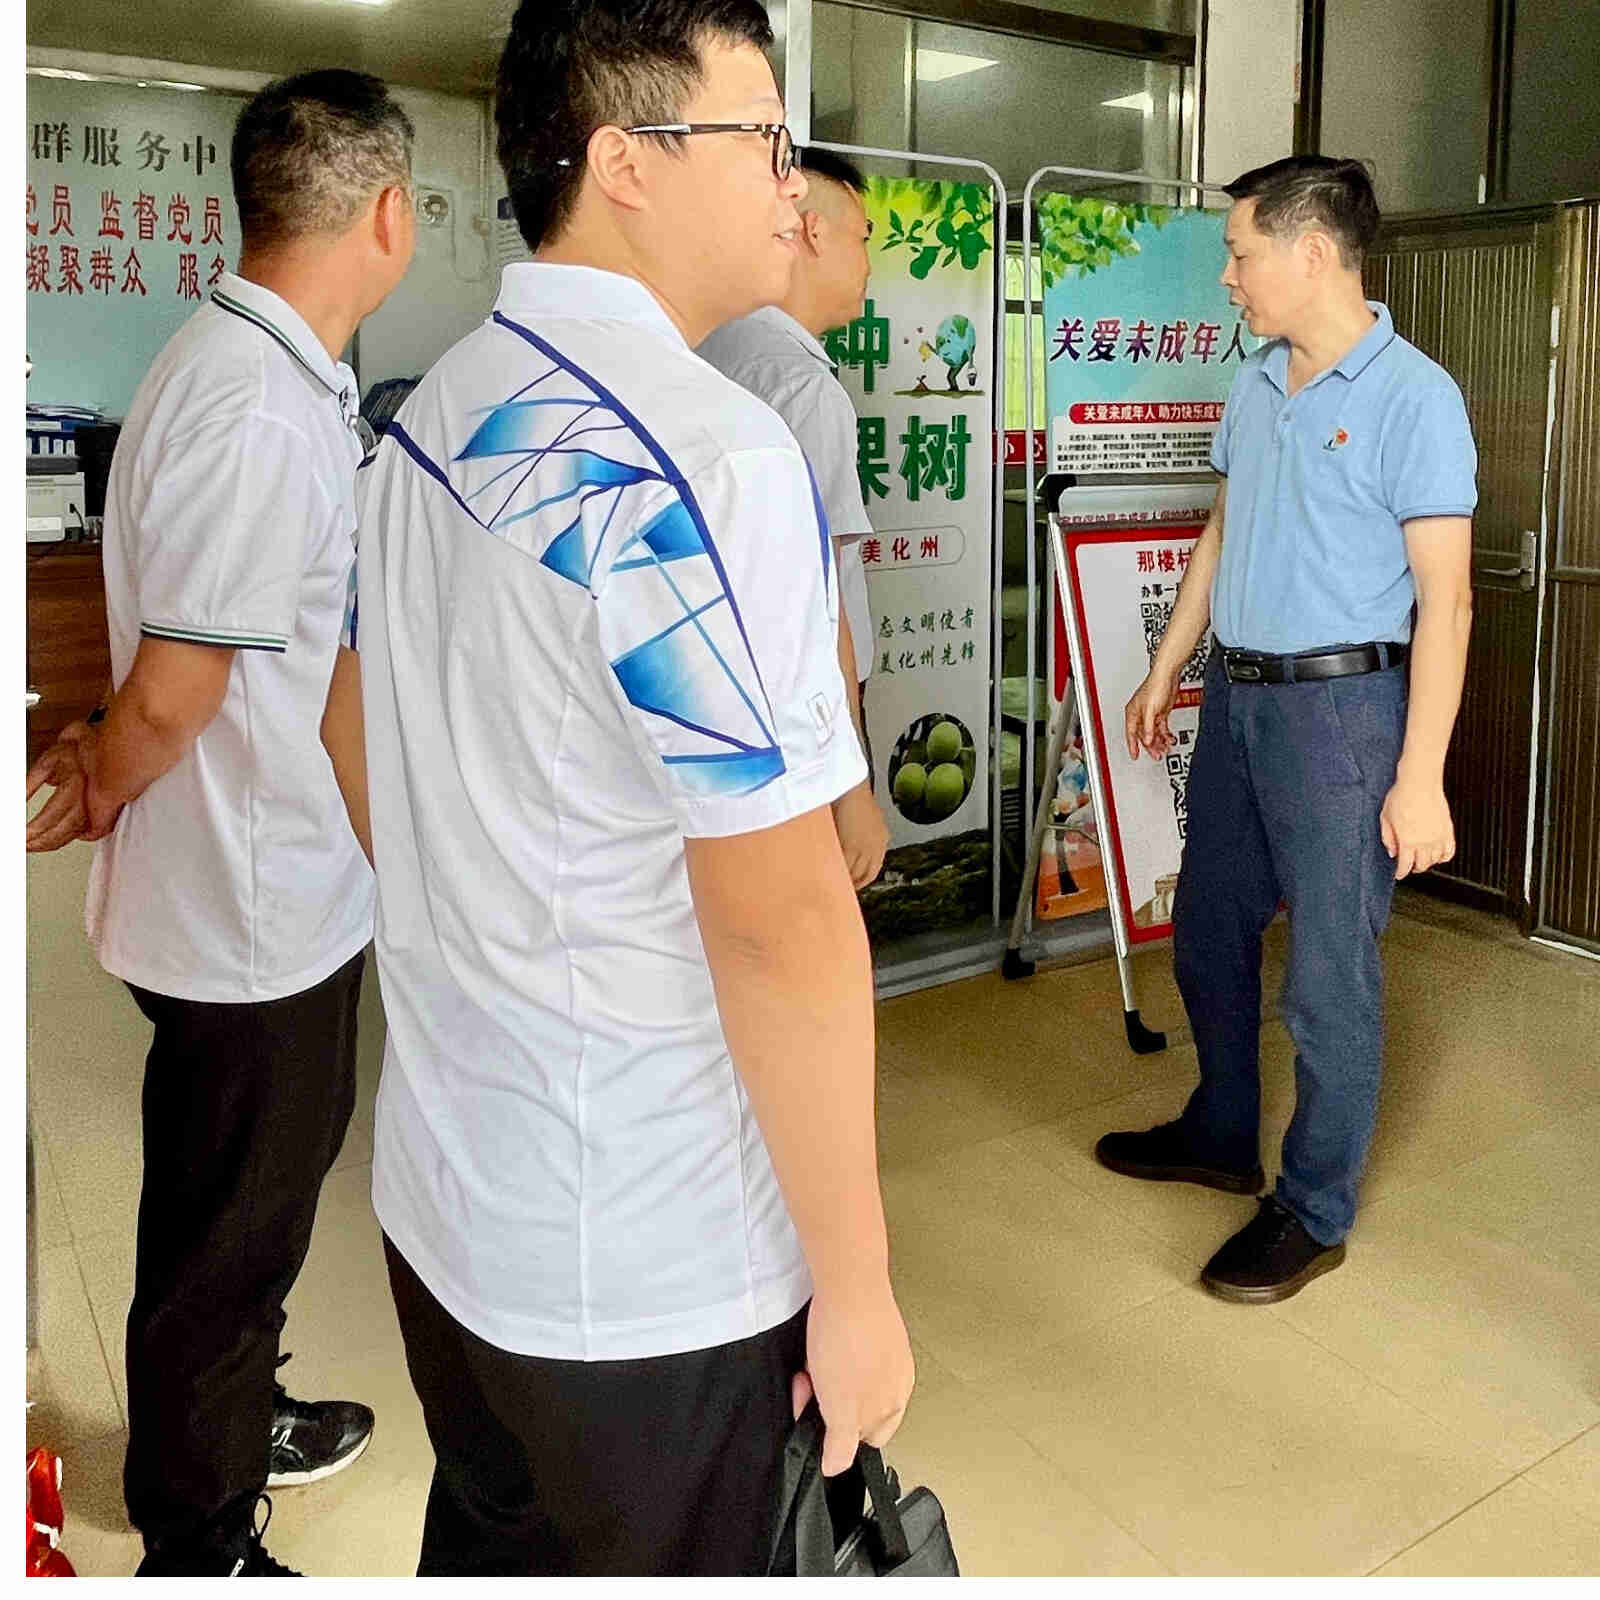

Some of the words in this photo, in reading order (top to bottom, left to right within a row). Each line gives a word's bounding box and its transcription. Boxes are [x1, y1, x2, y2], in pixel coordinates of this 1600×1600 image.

[98, 188, 224, 246] 监督党员
[1049, 318, 1248, 365] 关爱未成年人
